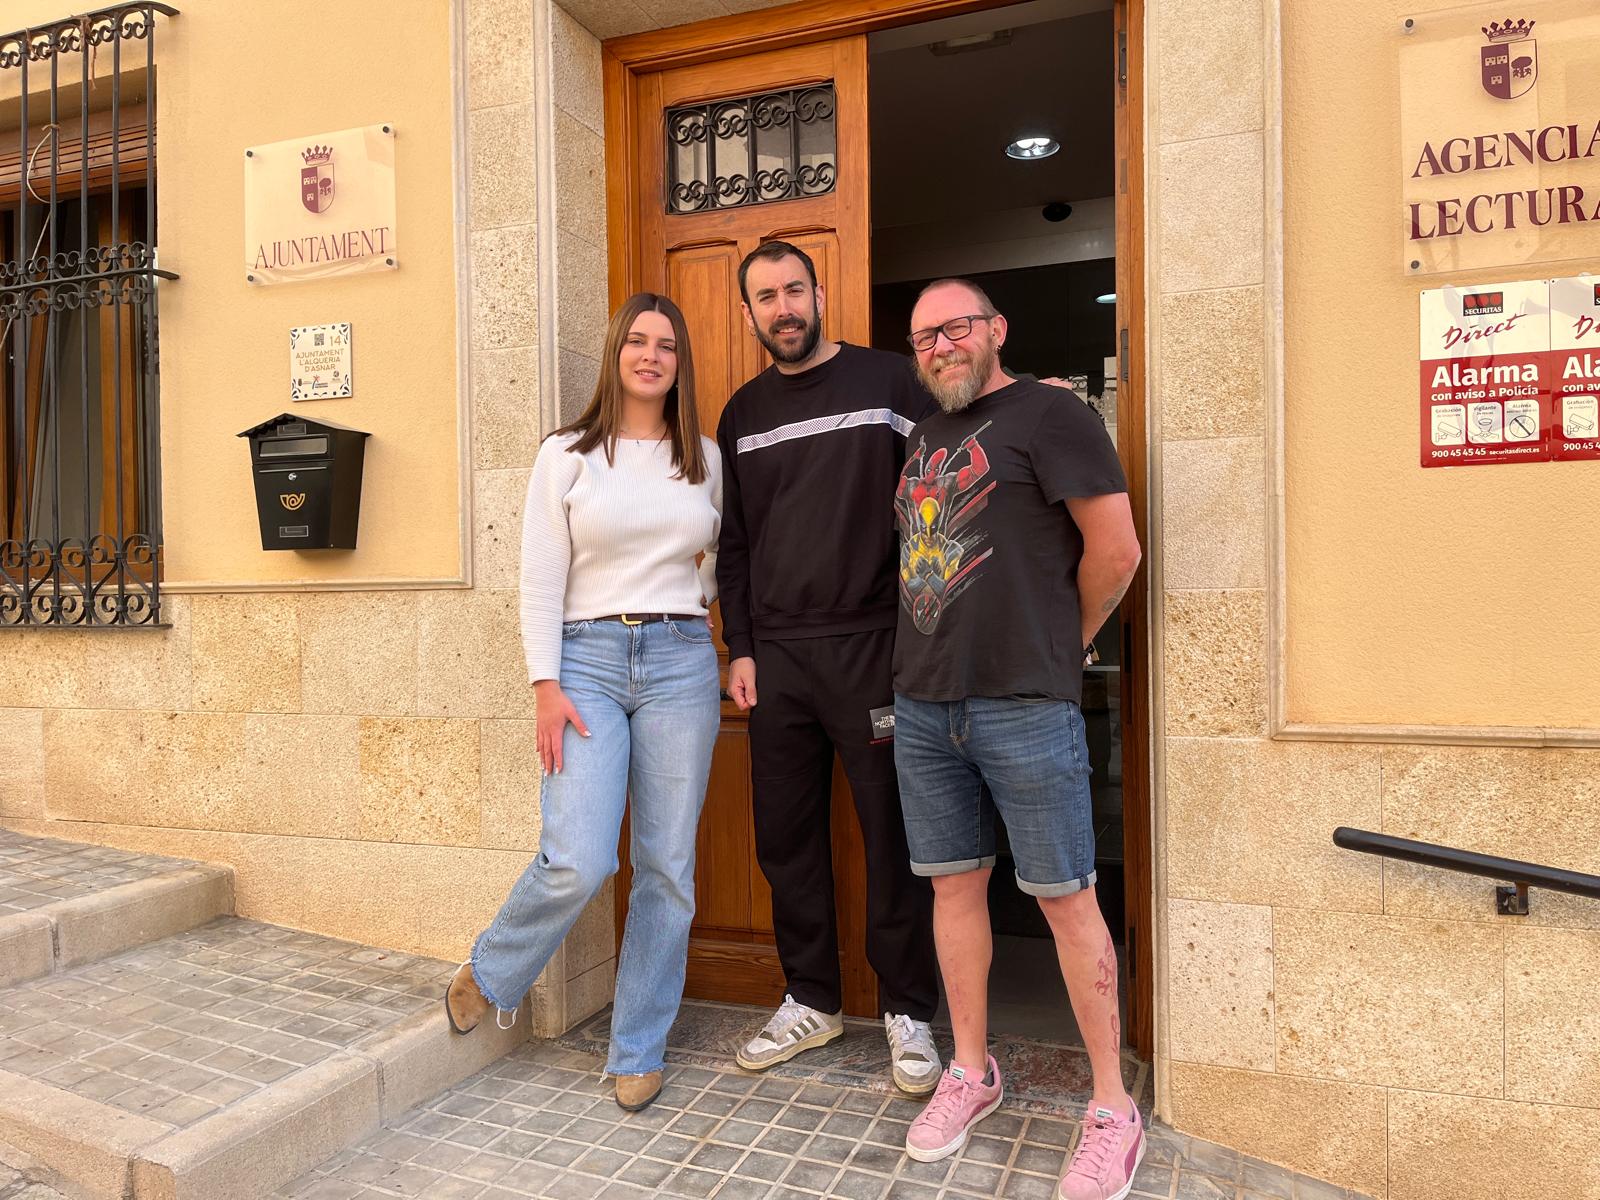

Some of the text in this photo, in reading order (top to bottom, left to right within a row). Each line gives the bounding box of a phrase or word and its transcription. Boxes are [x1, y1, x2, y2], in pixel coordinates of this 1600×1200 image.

[1409, 186, 1600, 240] LECTUR
[254, 226, 390, 270] AJUNTAMENT
[1464, 306, 1502, 316] SECURITAS
[1441, 313, 1528, 350] Direct
[329, 335, 342, 347] 14
[295, 348, 345, 359] AJUNTAMENT
[1431, 363, 1539, 388] Alarma
[1431, 384, 1539, 401] con aviso a Policía
[1562, 383, 1584, 393] con
[1431, 447, 1540, 458] 900 45 45 45 securitasdirect.es
[1563, 442, 1581, 451] 900
[1582, 442, 1594, 450] 45
